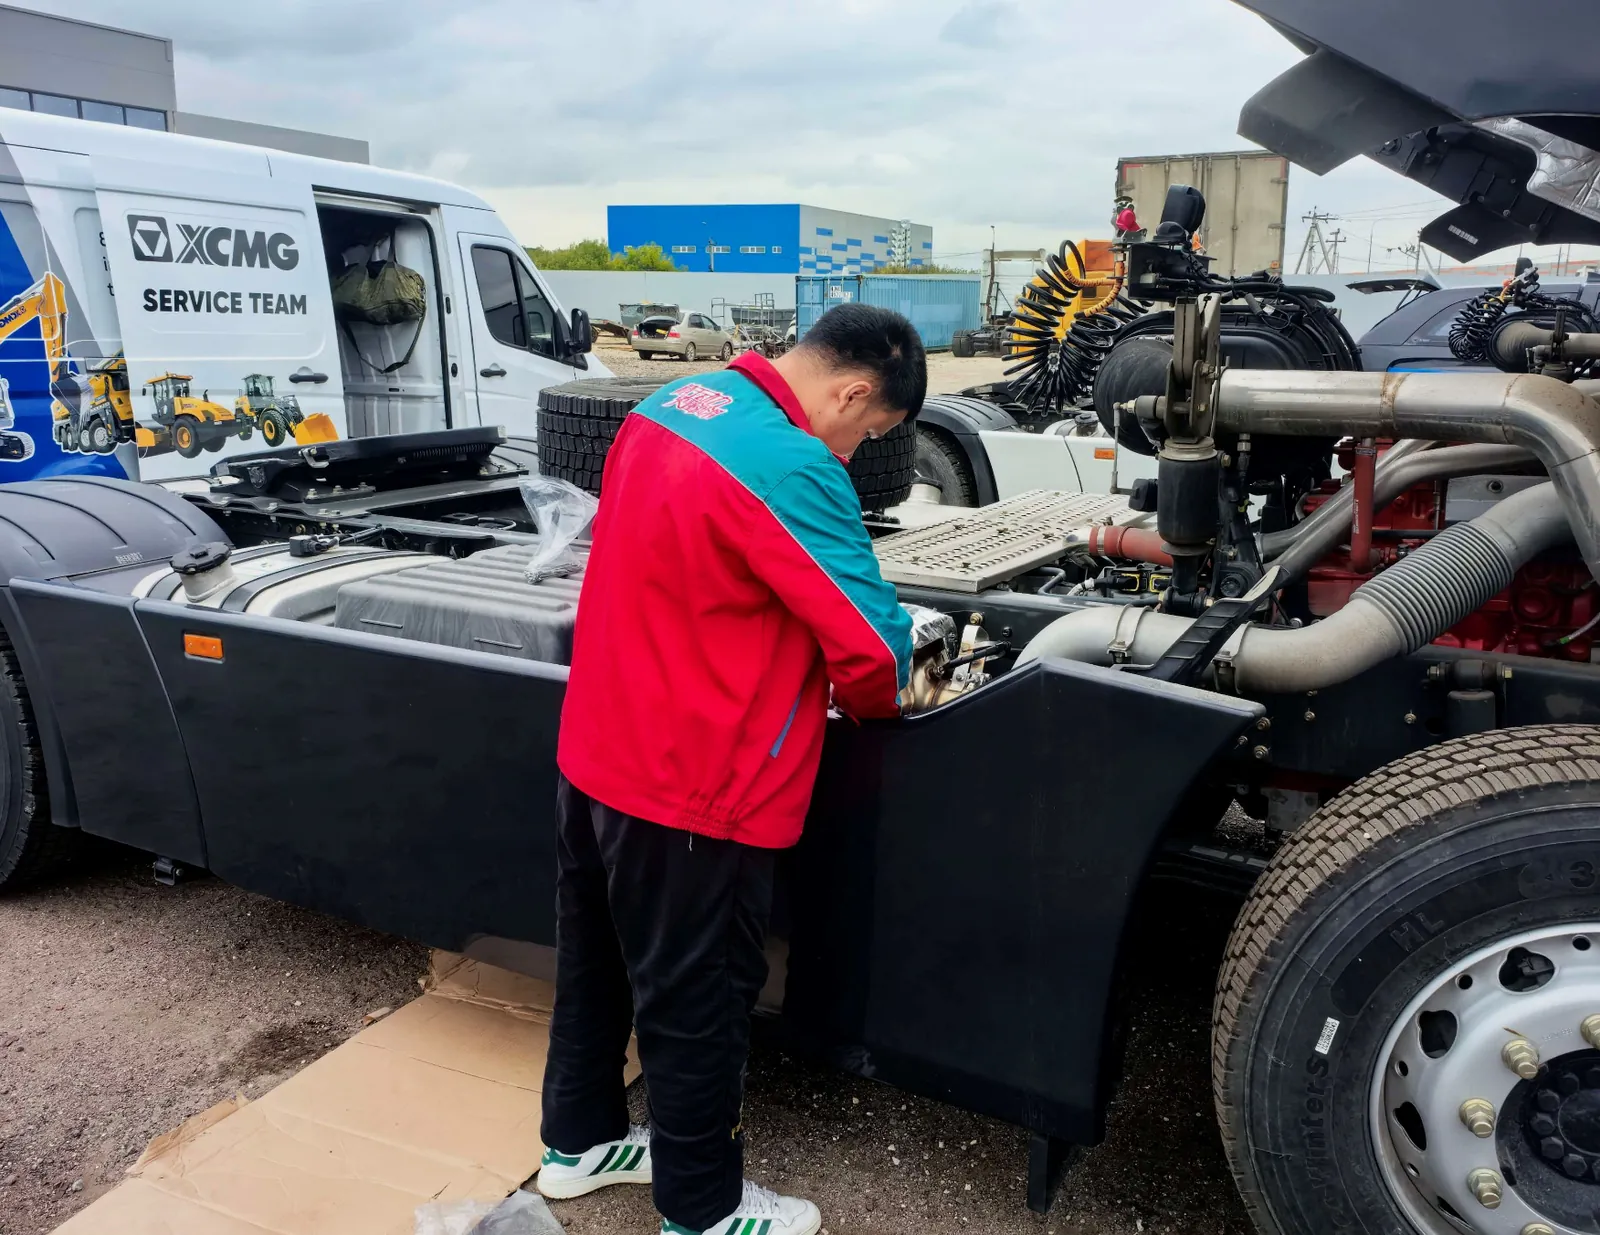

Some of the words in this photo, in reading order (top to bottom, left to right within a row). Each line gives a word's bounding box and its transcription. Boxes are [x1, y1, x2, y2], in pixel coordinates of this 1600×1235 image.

[175, 224, 300, 271] XCMG
[142, 288, 243, 314] SERVICE
[248, 292, 307, 315] TEAM
